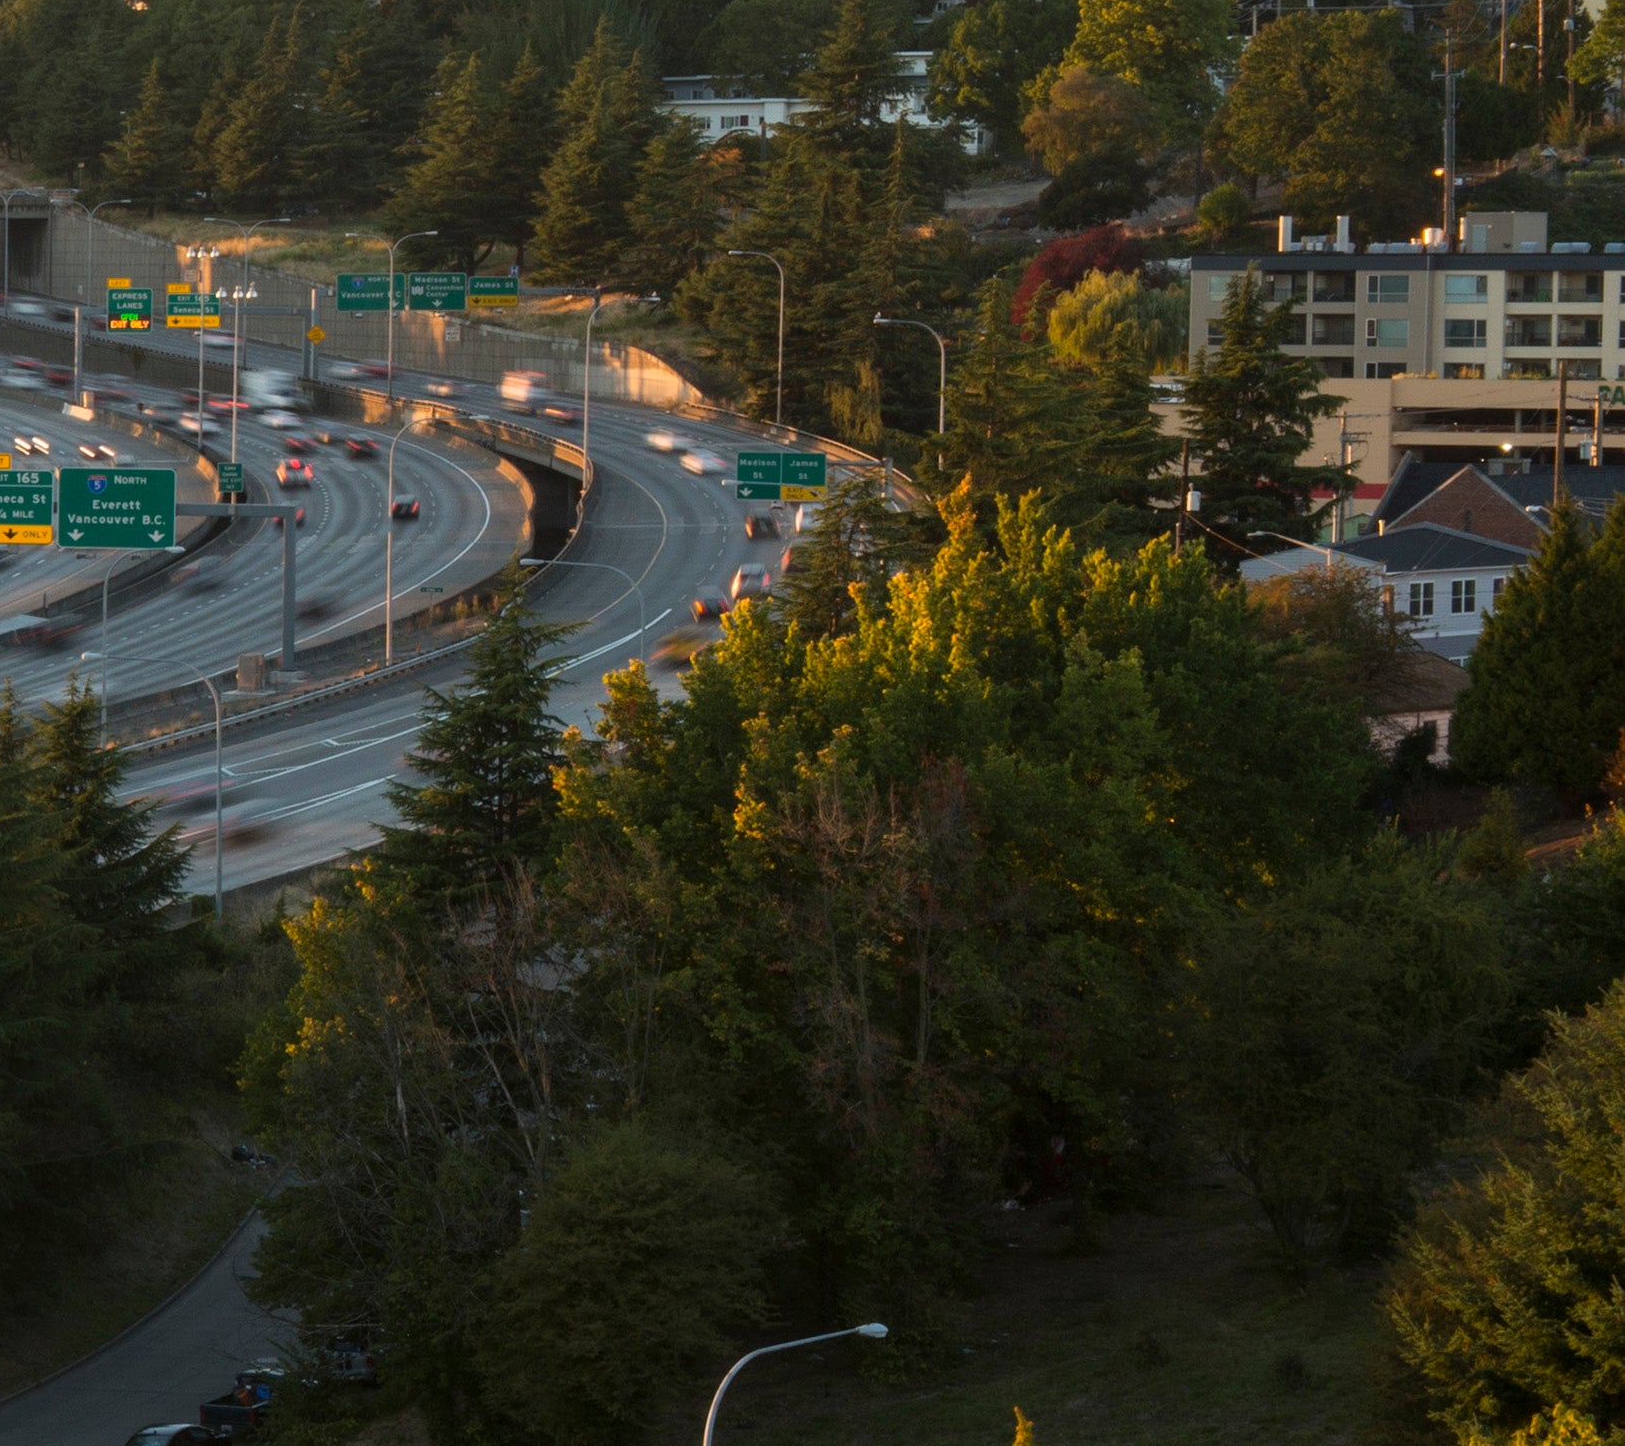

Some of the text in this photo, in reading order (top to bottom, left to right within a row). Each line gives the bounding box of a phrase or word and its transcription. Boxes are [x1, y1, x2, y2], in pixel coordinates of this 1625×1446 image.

[16, 473, 39, 483] 165
[114, 475, 147, 485] NORTH
[94, 480, 100, 490] 5
[32, 494, 46, 504] St
[92, 500, 141, 510] Everett
[12, 510, 34, 518] MILE
[68, 514, 165, 525] Vancouver B.C.
[22, 530, 48, 538] ONLY
